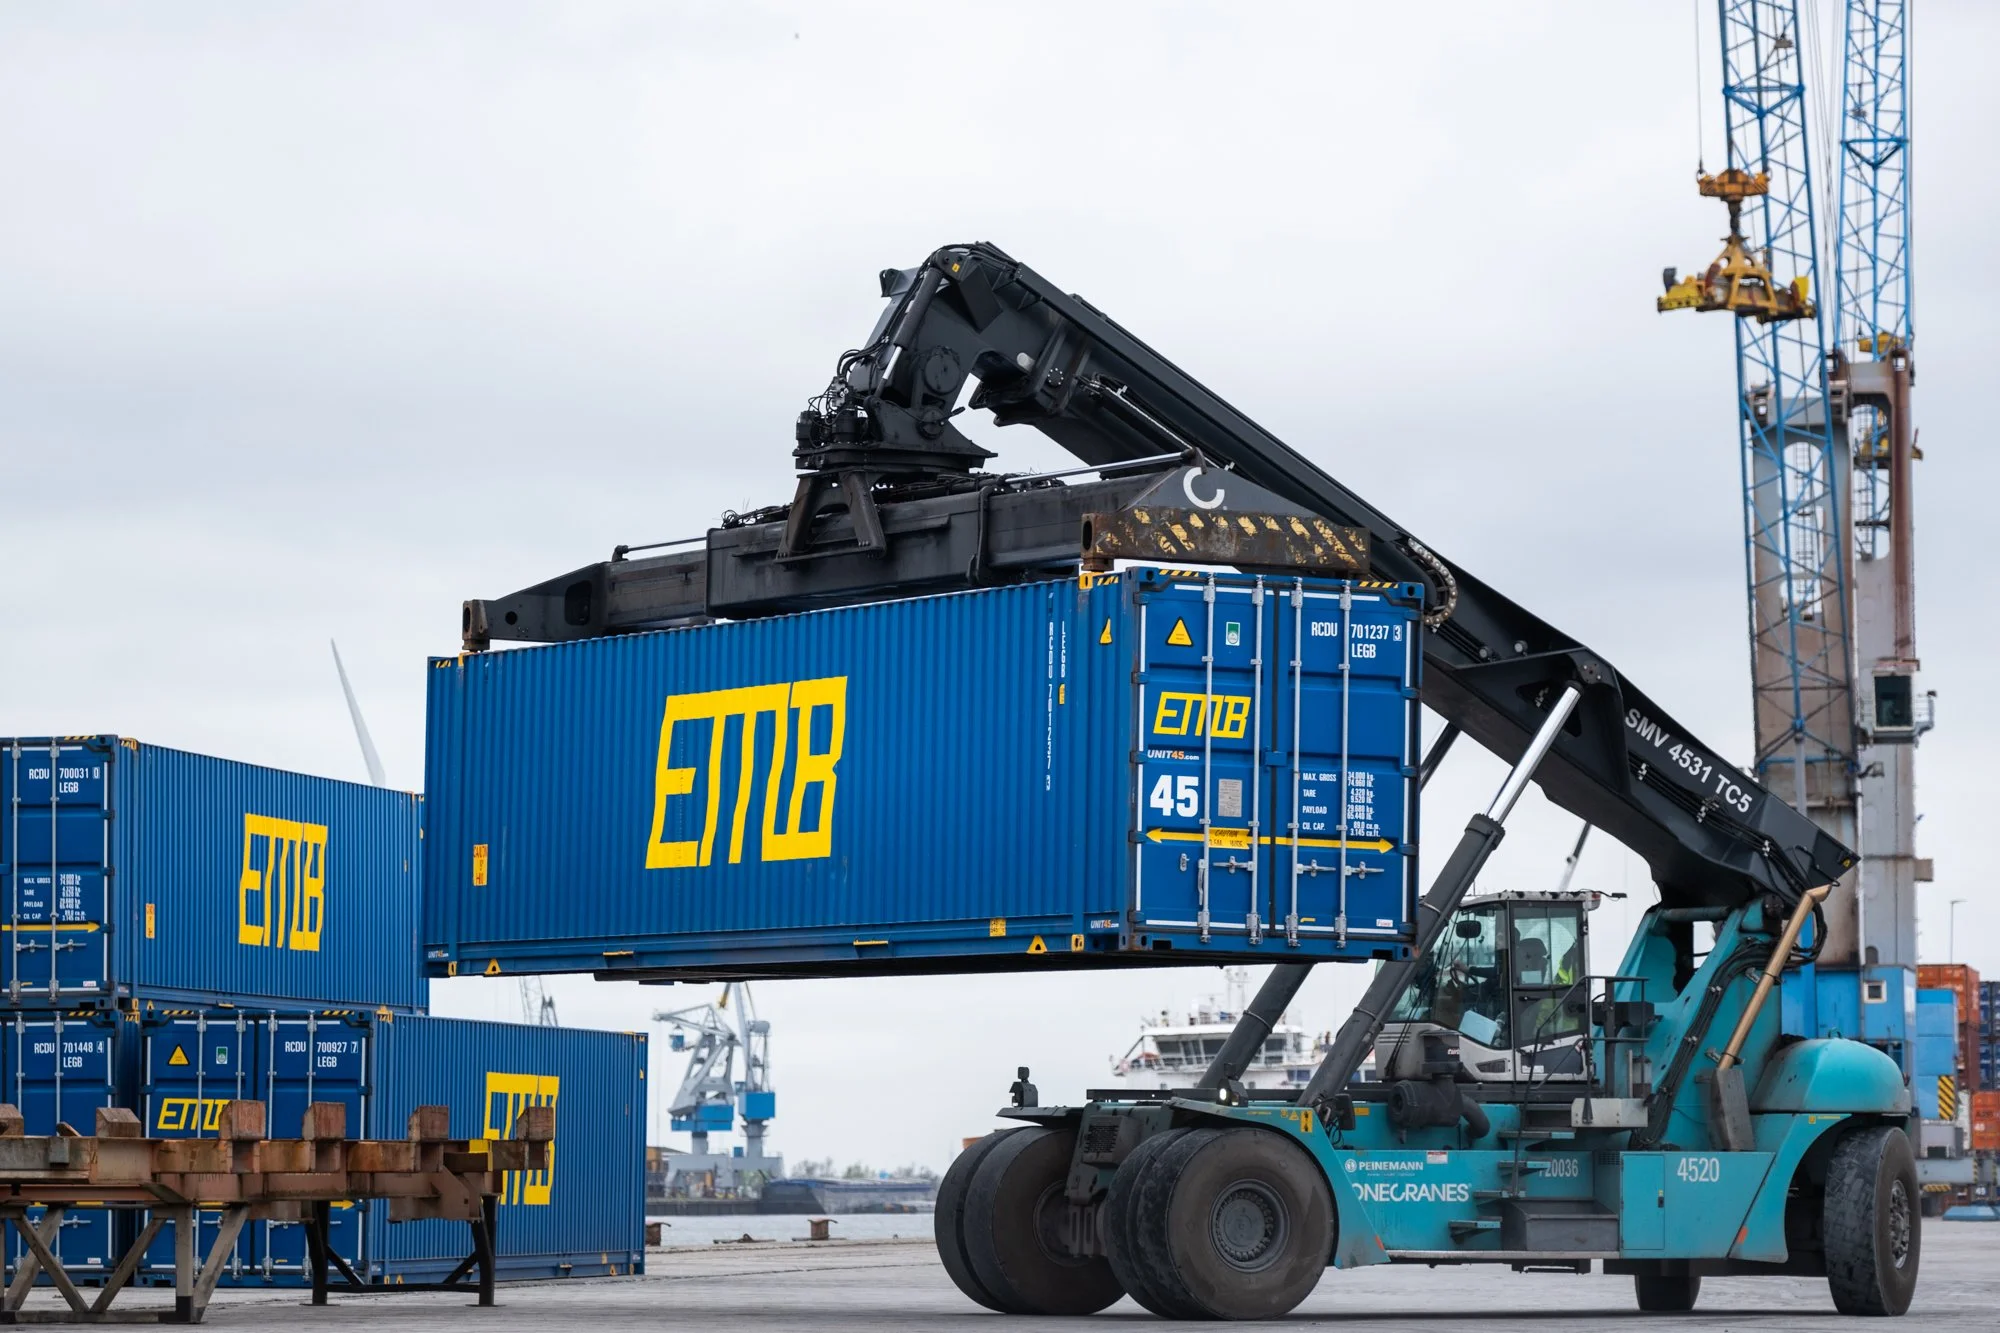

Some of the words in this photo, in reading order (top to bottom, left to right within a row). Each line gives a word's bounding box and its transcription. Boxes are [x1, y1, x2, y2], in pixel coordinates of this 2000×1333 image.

[1311, 622, 1338, 637] RCDU
[1350, 623, 1389, 640] 701237
[1394, 625, 1401, 641] 3
[1351, 643, 1376, 658] LEGB
[1147, 749, 1200, 761] UNIT45.com
[1625, 708, 1670, 748] SMV
[1669, 744, 1713, 783] 4531
[1715, 774, 1753, 813] TC5
[28, 768, 50, 780] RCDU
[59, 767, 89, 779] 700031
[1302, 772, 1318, 781] MAX.
[1319, 773, 1337, 782] GROSS
[59, 781, 79, 793] LEGB
[1150, 774, 1199, 818] 45
[1303, 789, 1316, 798] TARE
[1302, 805, 1328, 815] PAYLOAD
[1302, 822, 1312, 831] CU.
[1313, 822, 1326, 831] CAP.
[34, 1042, 55, 1054] RCDU
[62, 1041, 93, 1054] 701448
[97, 1041, 103, 1054] 4
[285, 1041, 306, 1053] RCDU
[316, 1041, 347, 1053] 700927
[351, 1041, 358, 1053] 7
[63, 1056, 83, 1068] LEGB
[317, 1056, 337, 1068] LEGB
[1359, 1161, 1424, 1171] PEINEMANN
[1677, 1157, 1720, 1182] 4520
